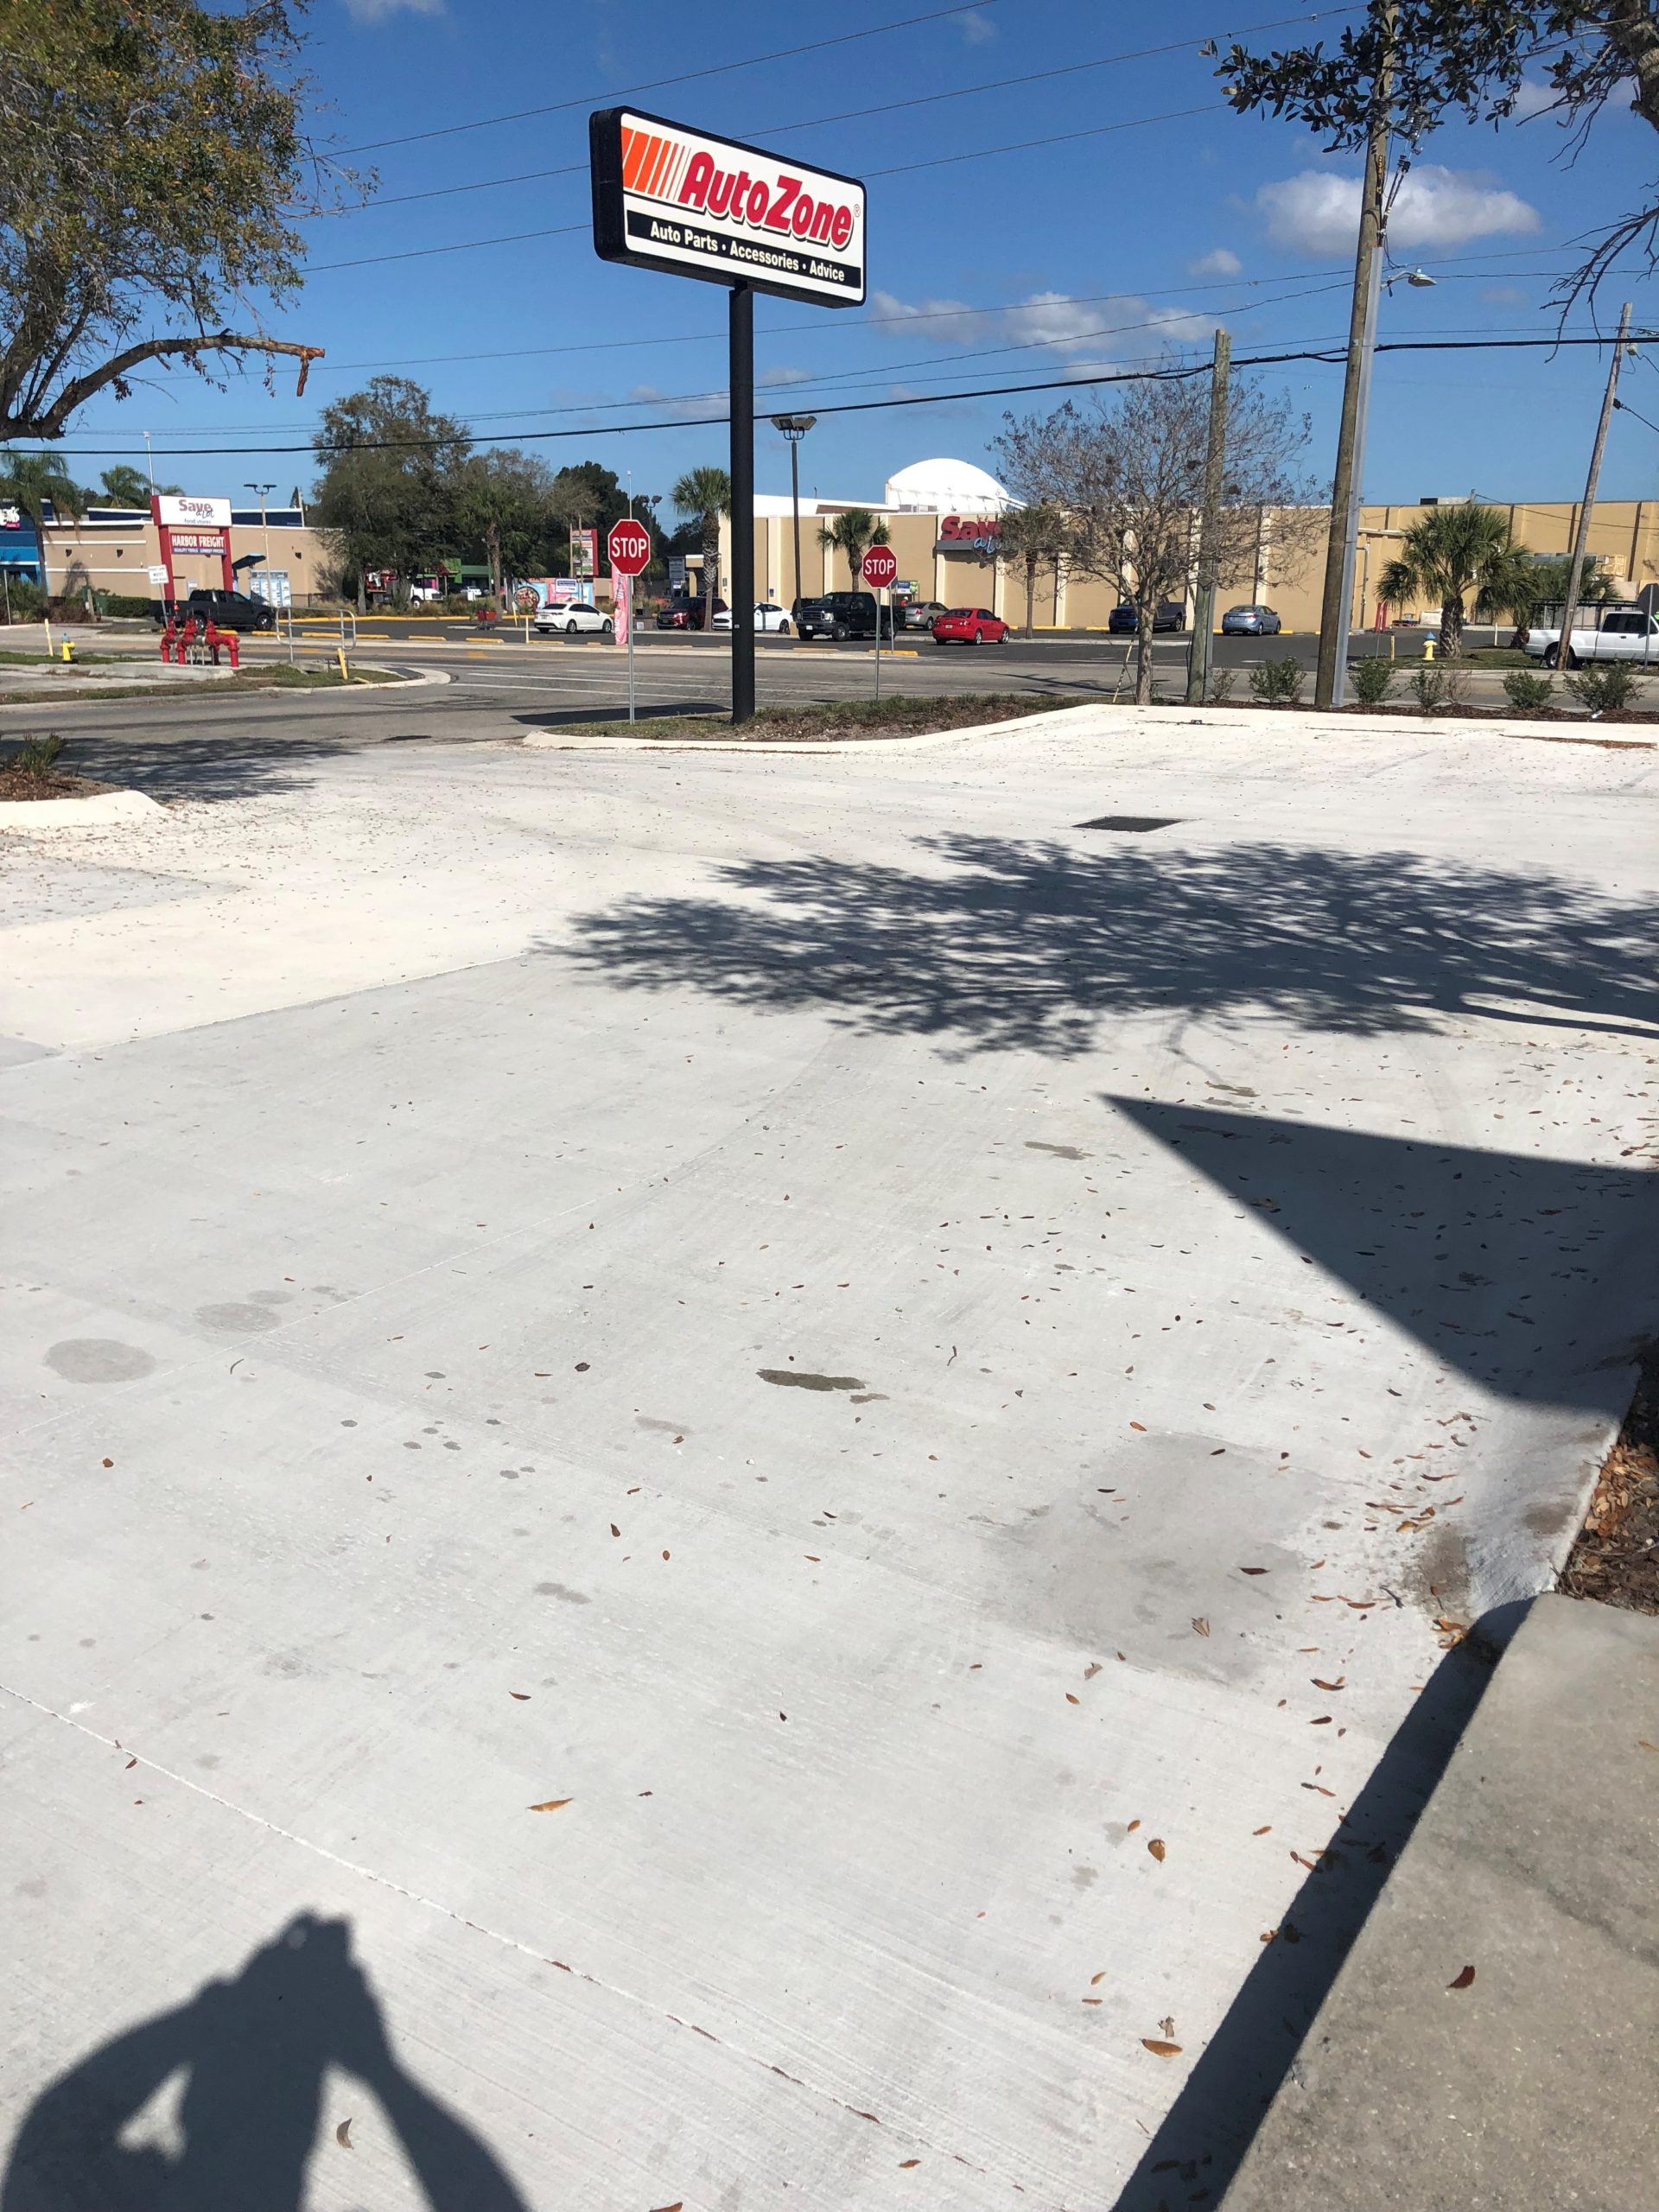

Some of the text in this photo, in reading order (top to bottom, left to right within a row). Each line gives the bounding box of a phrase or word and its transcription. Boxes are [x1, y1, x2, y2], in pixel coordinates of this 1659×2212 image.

[678, 151, 853, 249] AutoZone
[650, 221, 845, 282] Auto Parts Accessories Advice
[178, 499, 212, 512] Save
[171, 535, 225, 548] HARBOR FREIGHT
[612, 537, 647, 558] STOP
[865, 559, 895, 575] STOP
